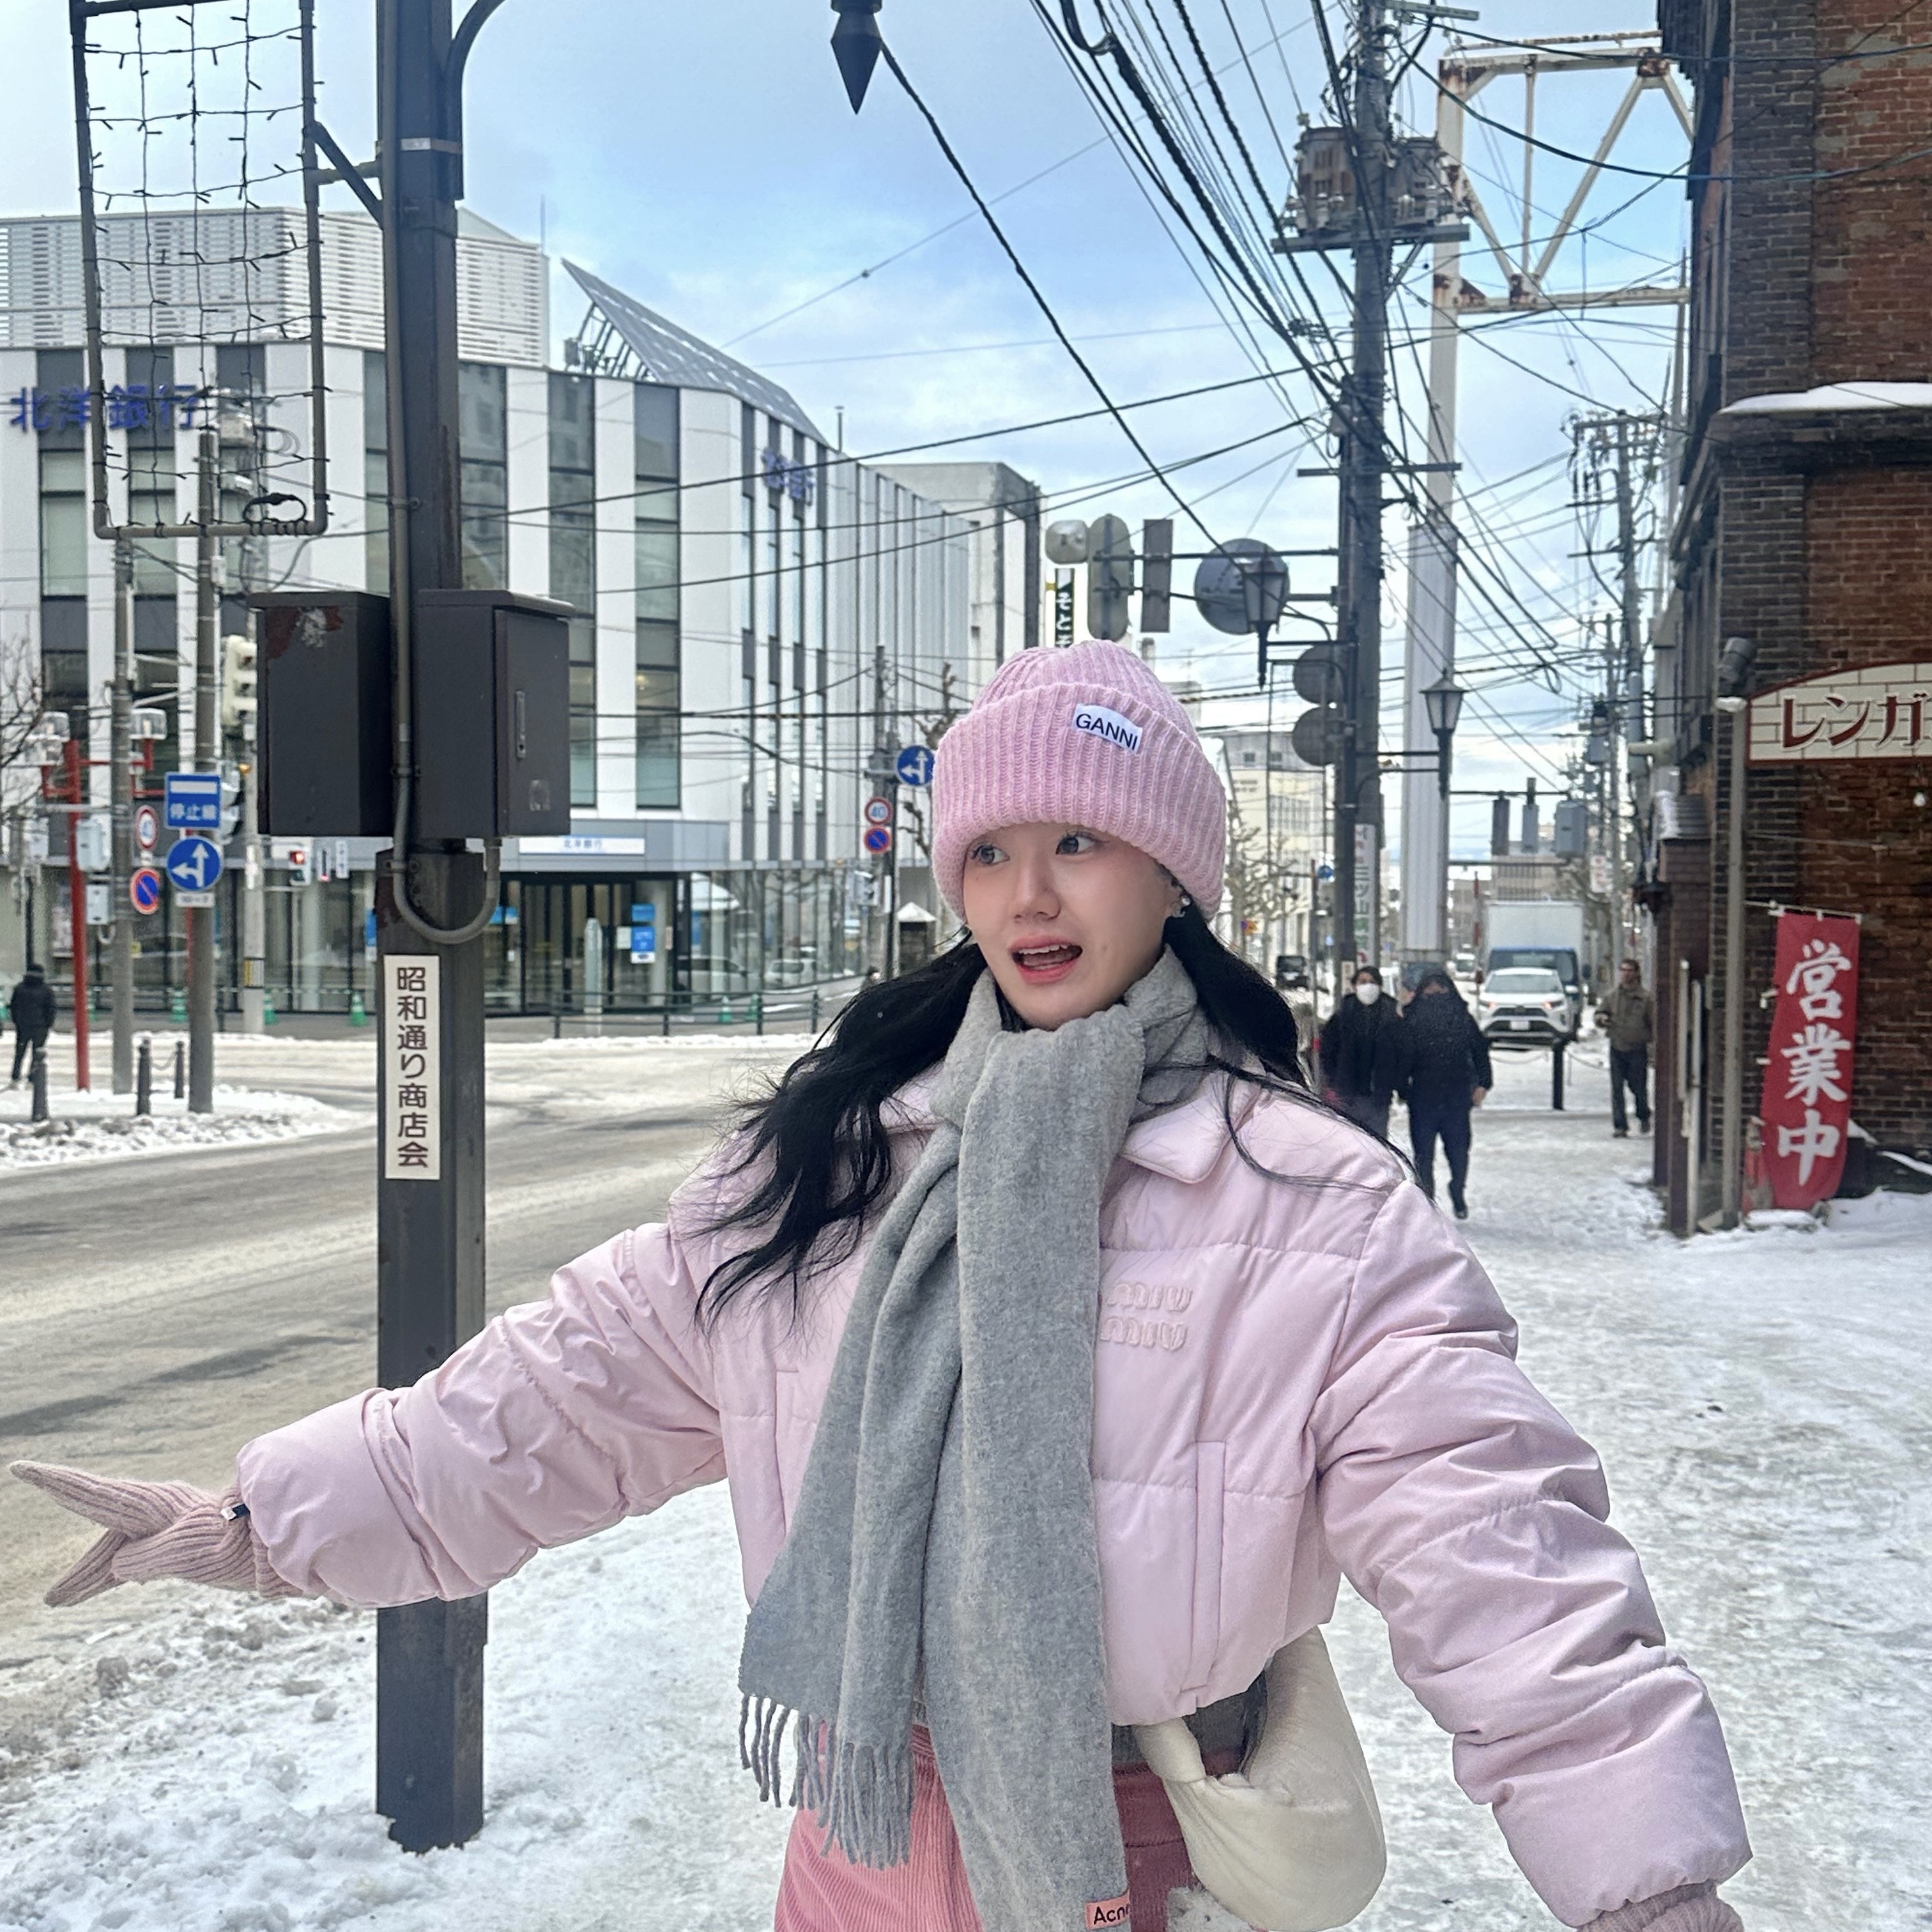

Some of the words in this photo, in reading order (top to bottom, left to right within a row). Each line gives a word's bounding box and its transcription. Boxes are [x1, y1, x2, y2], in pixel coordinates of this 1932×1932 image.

[1076, 713, 1138, 750] GANNI
[1783, 693, 1928, 747] レンガ
[871, 806, 884, 818] 40
[397, 967, 429, 1168] 昭和通り商店会
[1777, 939, 1852, 1186] 営業中
